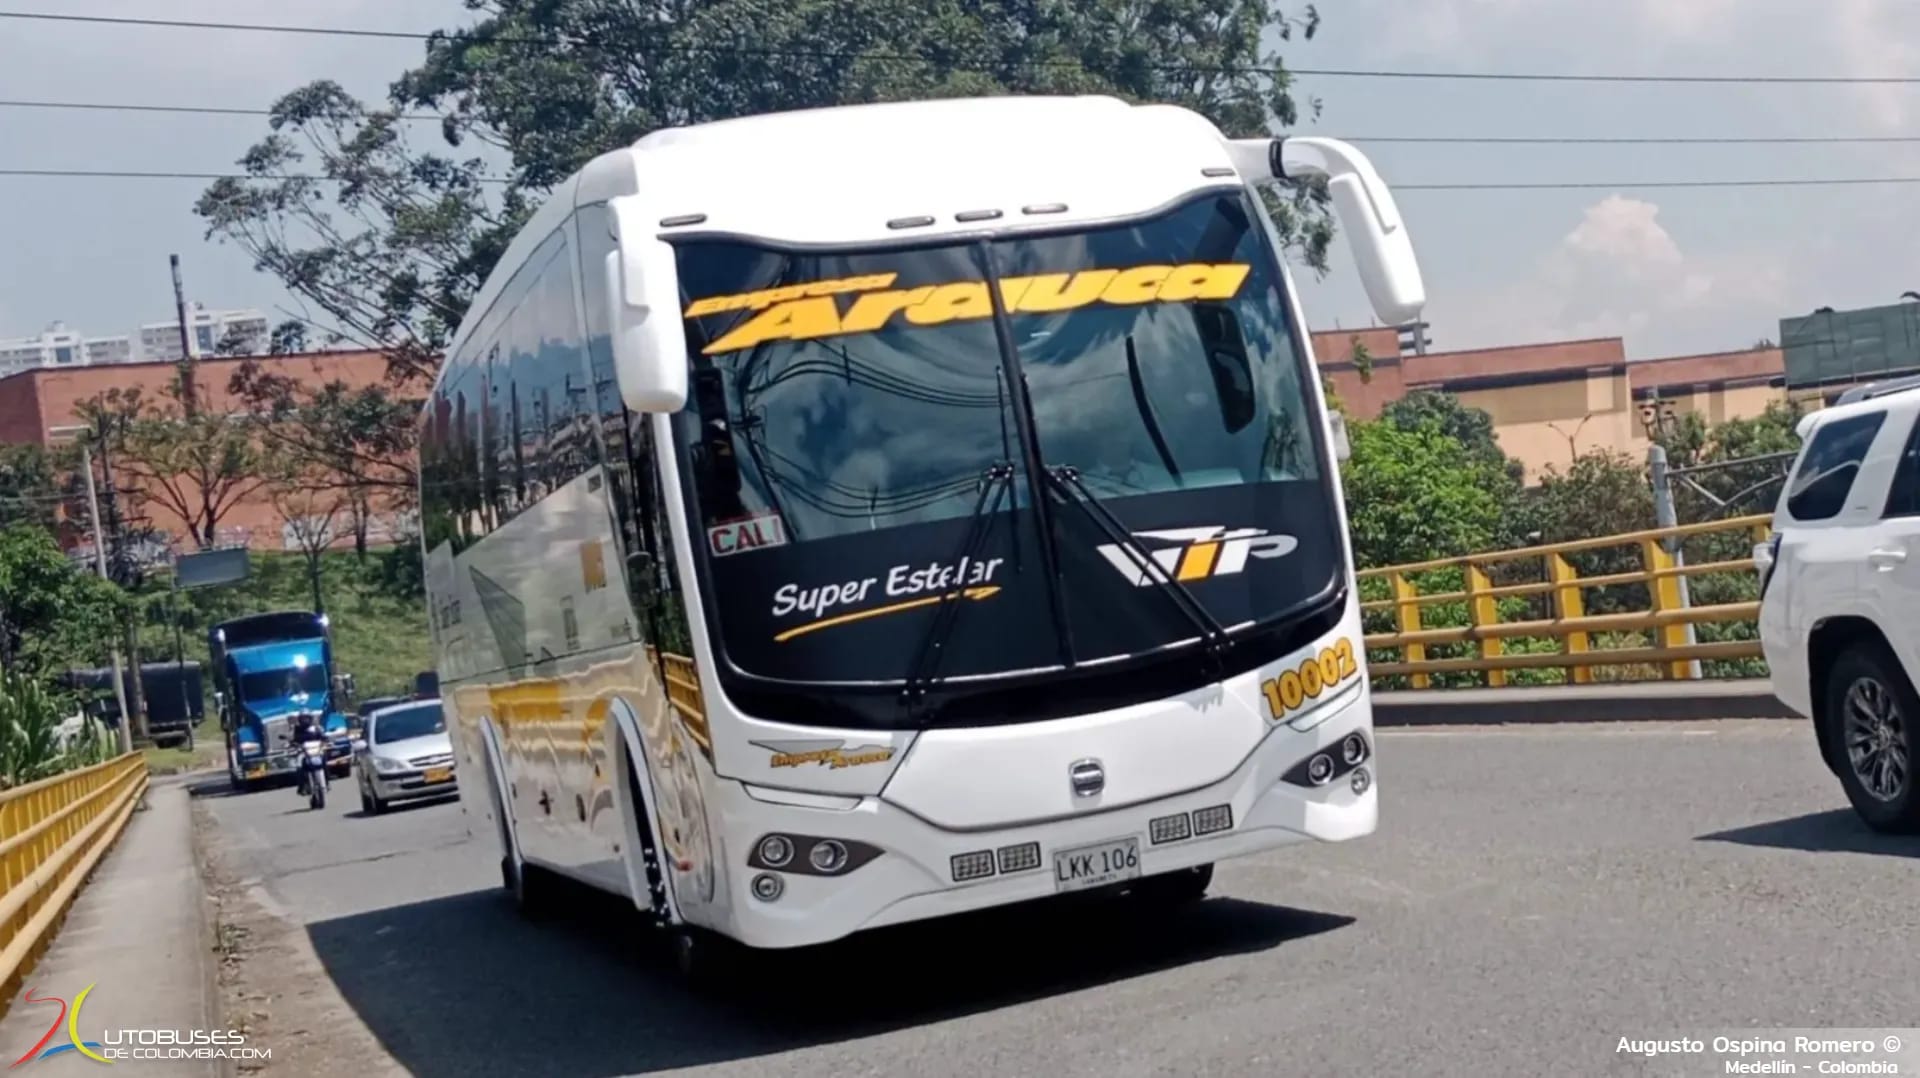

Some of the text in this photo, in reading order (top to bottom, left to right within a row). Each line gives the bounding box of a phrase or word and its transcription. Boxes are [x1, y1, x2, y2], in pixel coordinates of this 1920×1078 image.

[702, 264, 1251, 354] Arauca
[711, 517, 783, 553] CALI
[771, 556, 1003, 616] Super Estelar
[1261, 637, 1358, 720] 10002
[1057, 854, 1094, 881] LKK
[1101, 845, 1137, 873] 106
